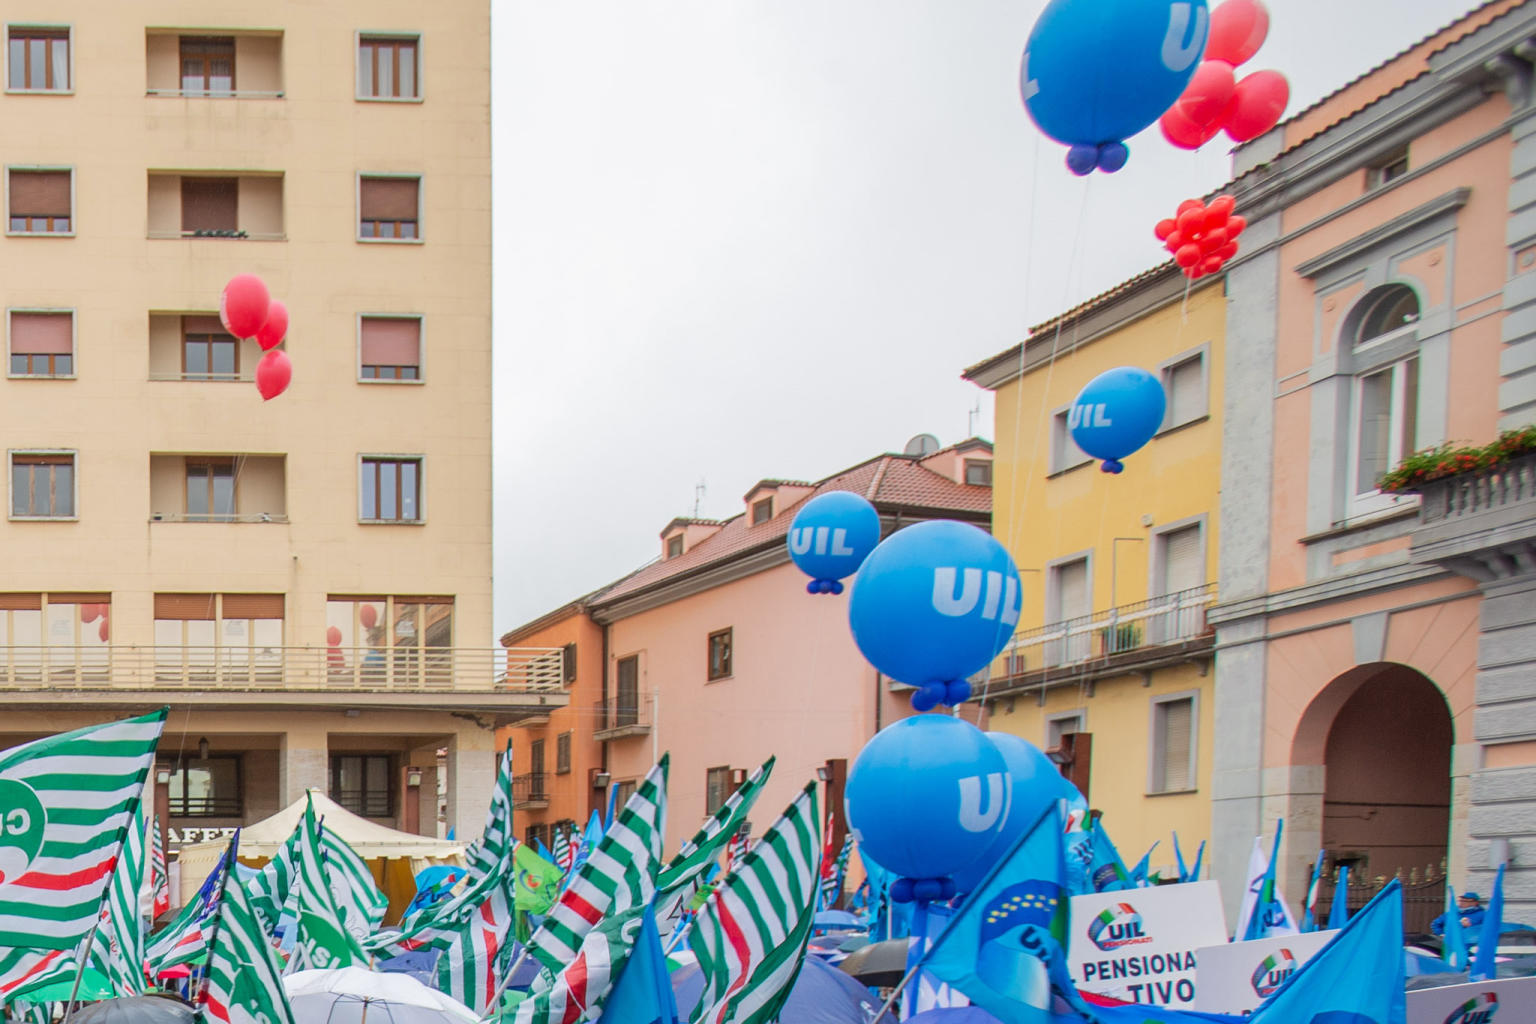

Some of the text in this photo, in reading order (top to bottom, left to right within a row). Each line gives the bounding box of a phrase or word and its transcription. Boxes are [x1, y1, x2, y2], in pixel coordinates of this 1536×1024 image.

[1069, 403, 1112, 430] UIL
[791, 526, 854, 556] UIL
[932, 567, 1020, 627] UIL
[1108, 922, 1145, 940] UIL
